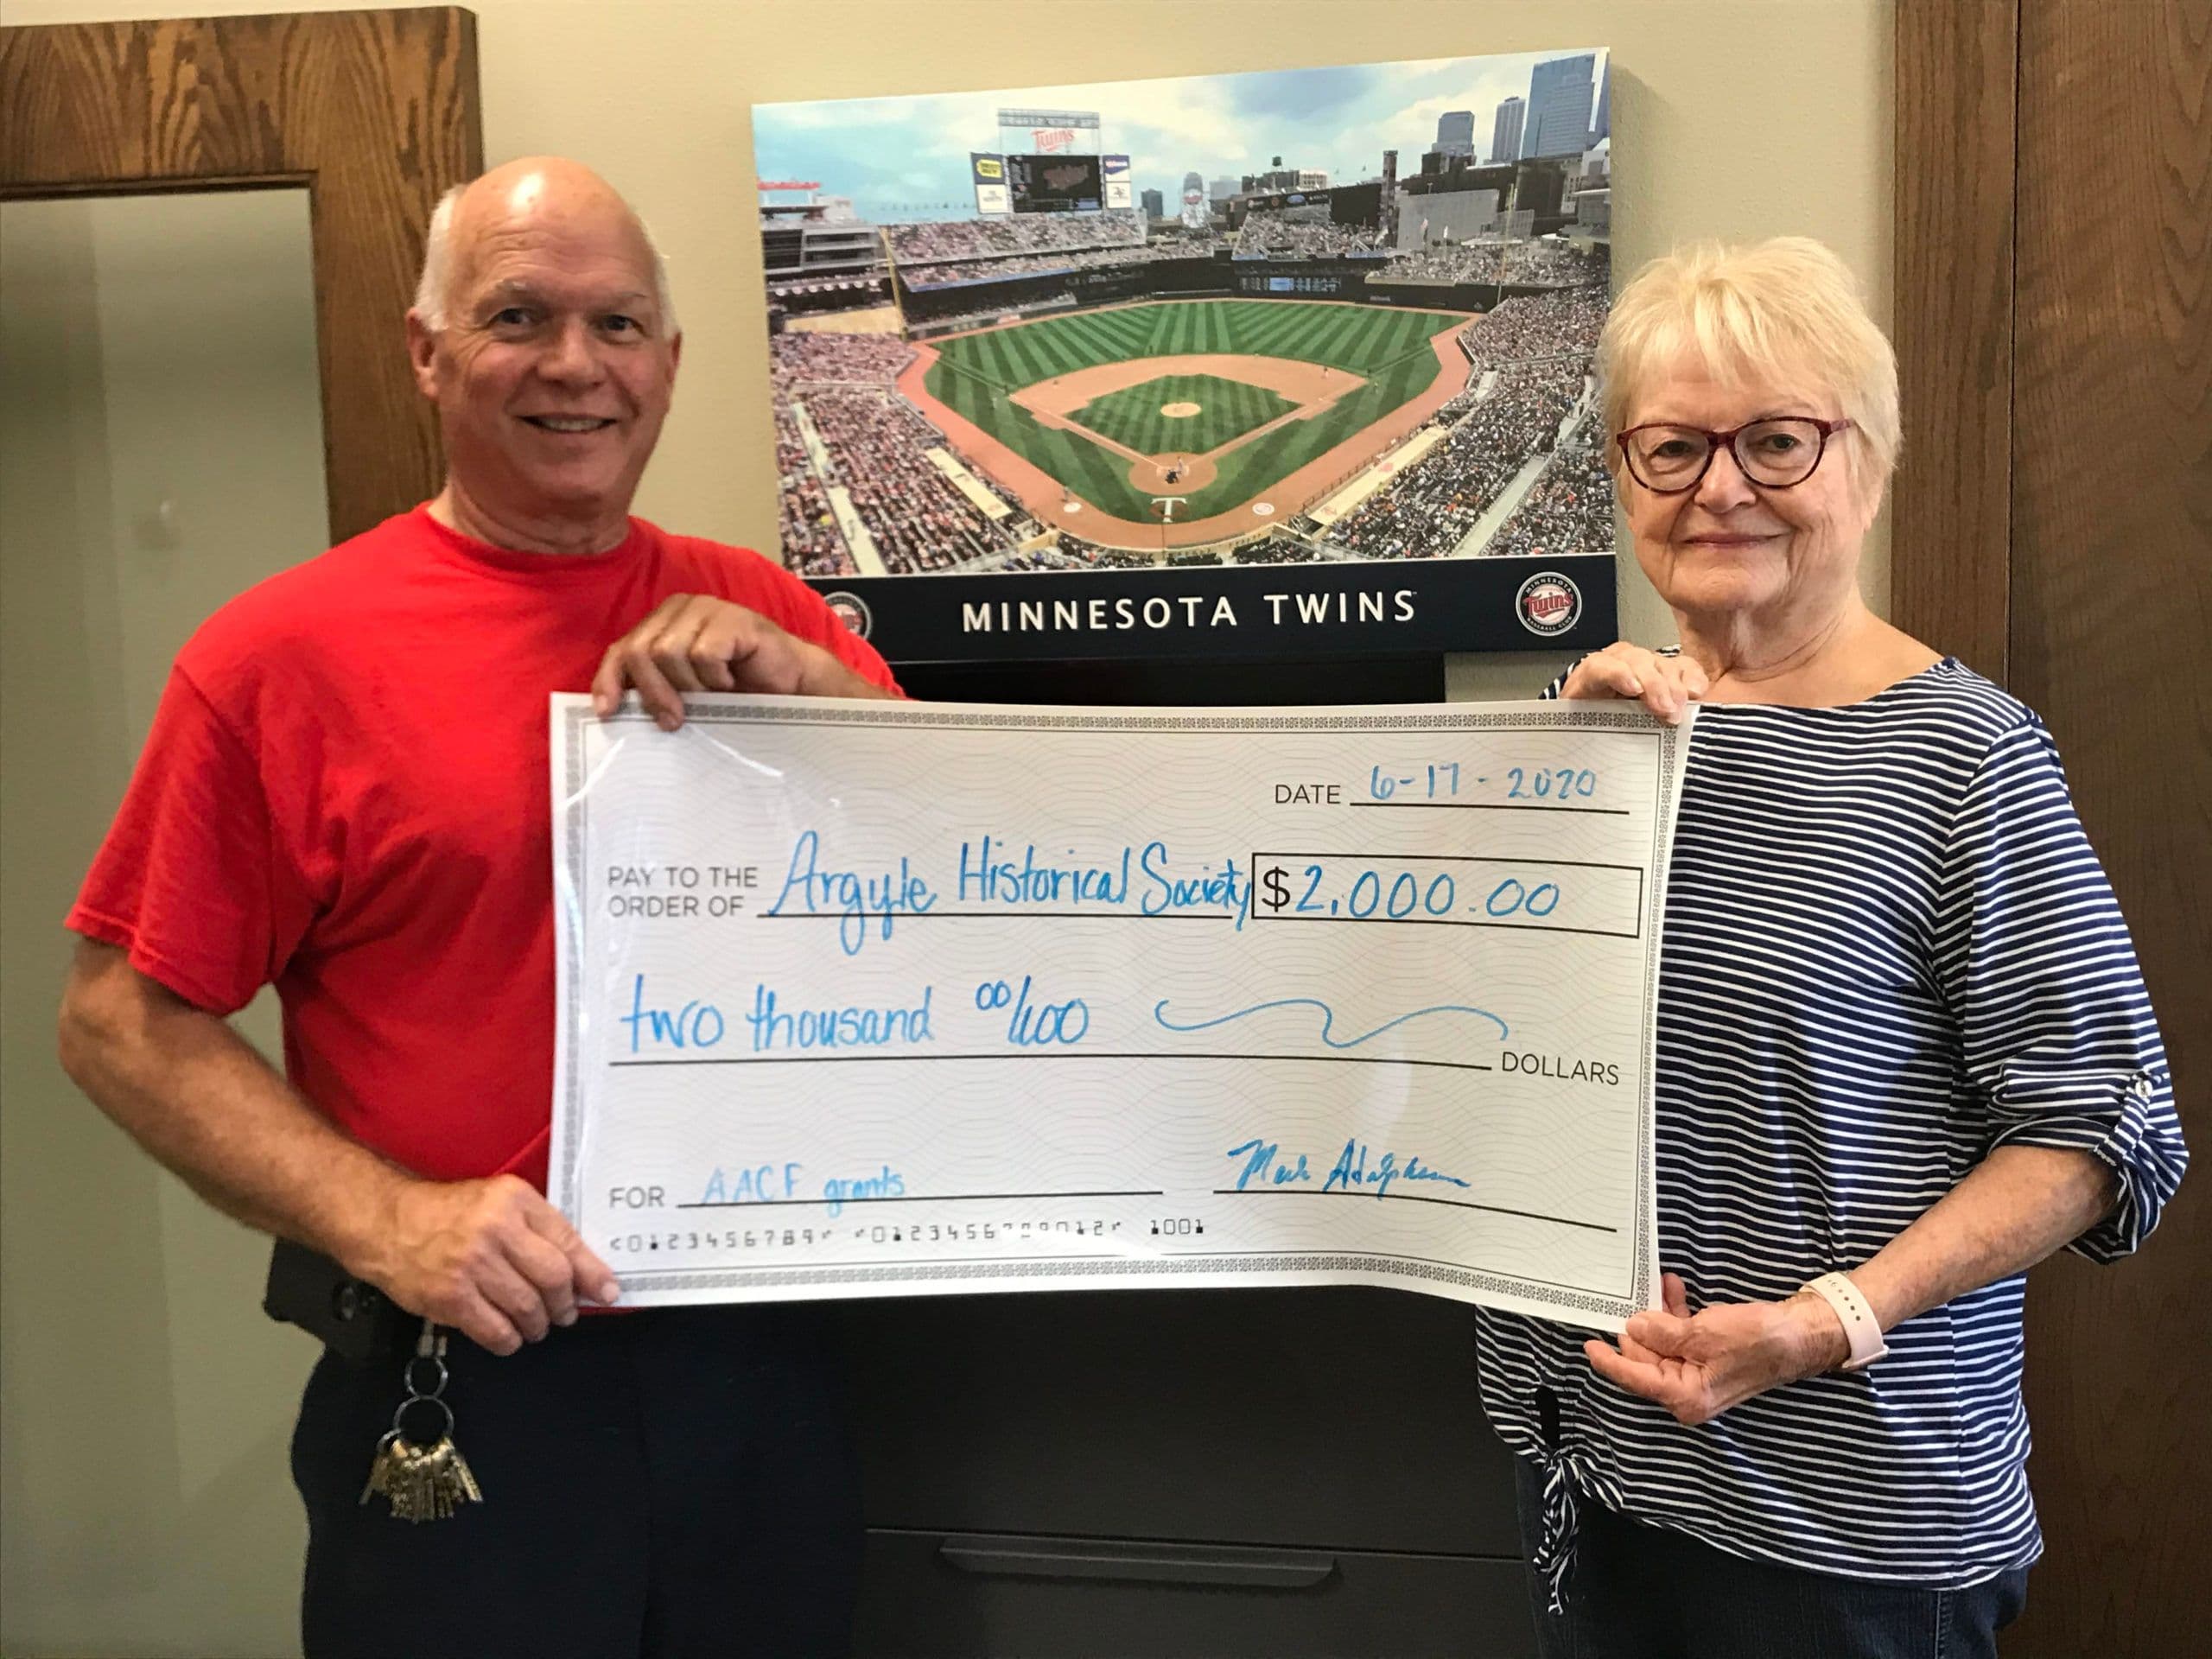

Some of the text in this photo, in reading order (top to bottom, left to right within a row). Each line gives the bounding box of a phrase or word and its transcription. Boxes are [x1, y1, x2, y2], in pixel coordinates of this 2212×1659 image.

[1525, 577, 1573, 594] MINNESOTA
[962, 590, 1414, 632] MINNESOTA TWINS
[1274, 784, 1342, 804] DATE
[608, 866, 758, 888] PAY TO THE
[768, 830, 1251, 956] Argyle Historical Society
[608, 895, 744, 918] ORDER OF
[620, 975, 724, 1052] two
[747, 984, 936, 1052] thousand
[1501, 1052, 1619, 1087] DOLLARS
[609, 1185, 665, 1209] FOR
[824, 1166, 904, 1218] grants
[1150, 1218, 1204, 1236] 1001
